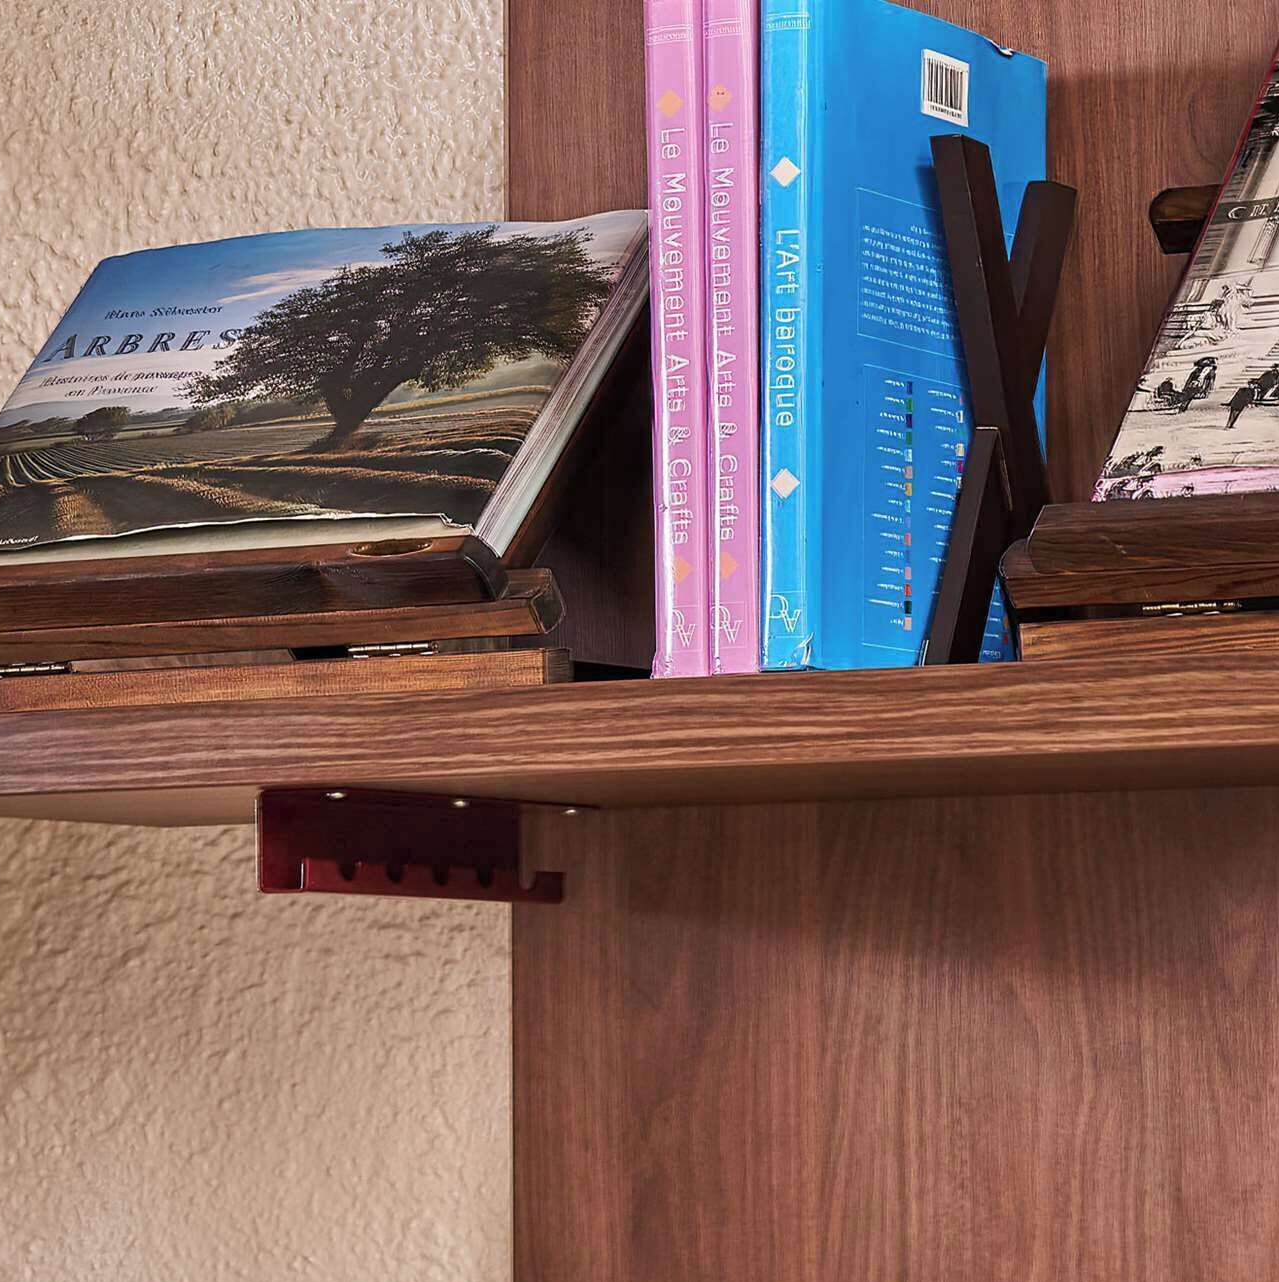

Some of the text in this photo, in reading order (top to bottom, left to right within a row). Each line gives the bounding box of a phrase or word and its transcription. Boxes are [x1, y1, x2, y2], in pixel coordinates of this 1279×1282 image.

[43, 327, 242, 363] ARBRES
[661, 127, 694, 545] Le Mouvement Arts & Crafts
[709, 120, 740, 541] Le Mouvement Arts & Crafts
[775, 228, 801, 428] L'Art baroque
